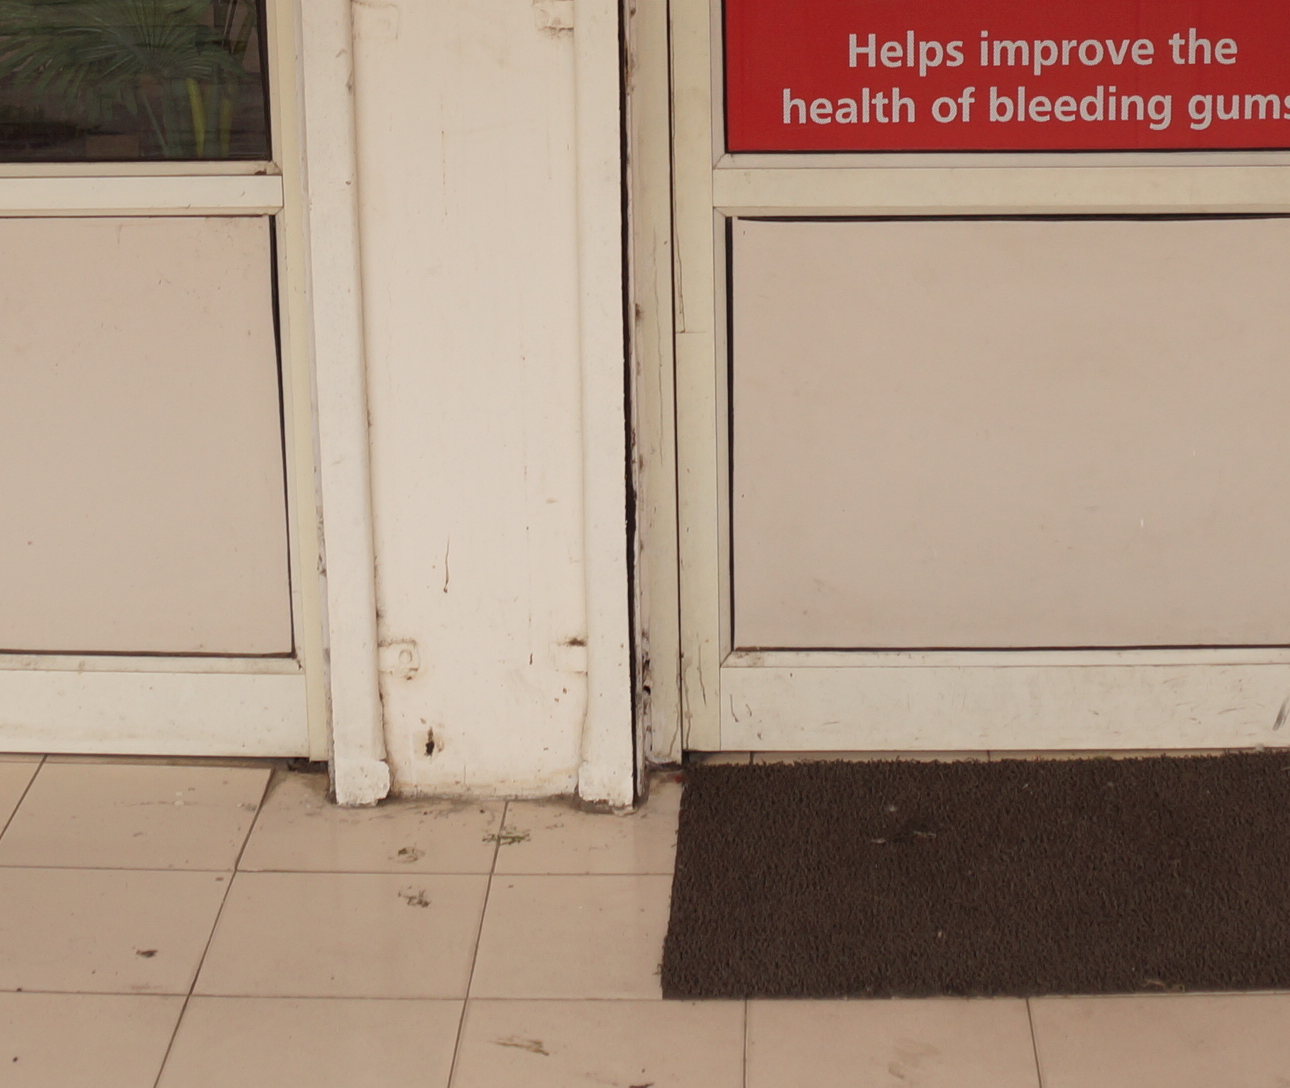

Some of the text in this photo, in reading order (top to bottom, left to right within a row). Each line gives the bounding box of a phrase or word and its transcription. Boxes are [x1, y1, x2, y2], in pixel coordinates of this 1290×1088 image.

[847, 27, 1240, 77] Helps improve the
[782, 87, 917, 125] health
[931, 86, 976, 124] of
[988, 84, 1174, 131] bleeding
